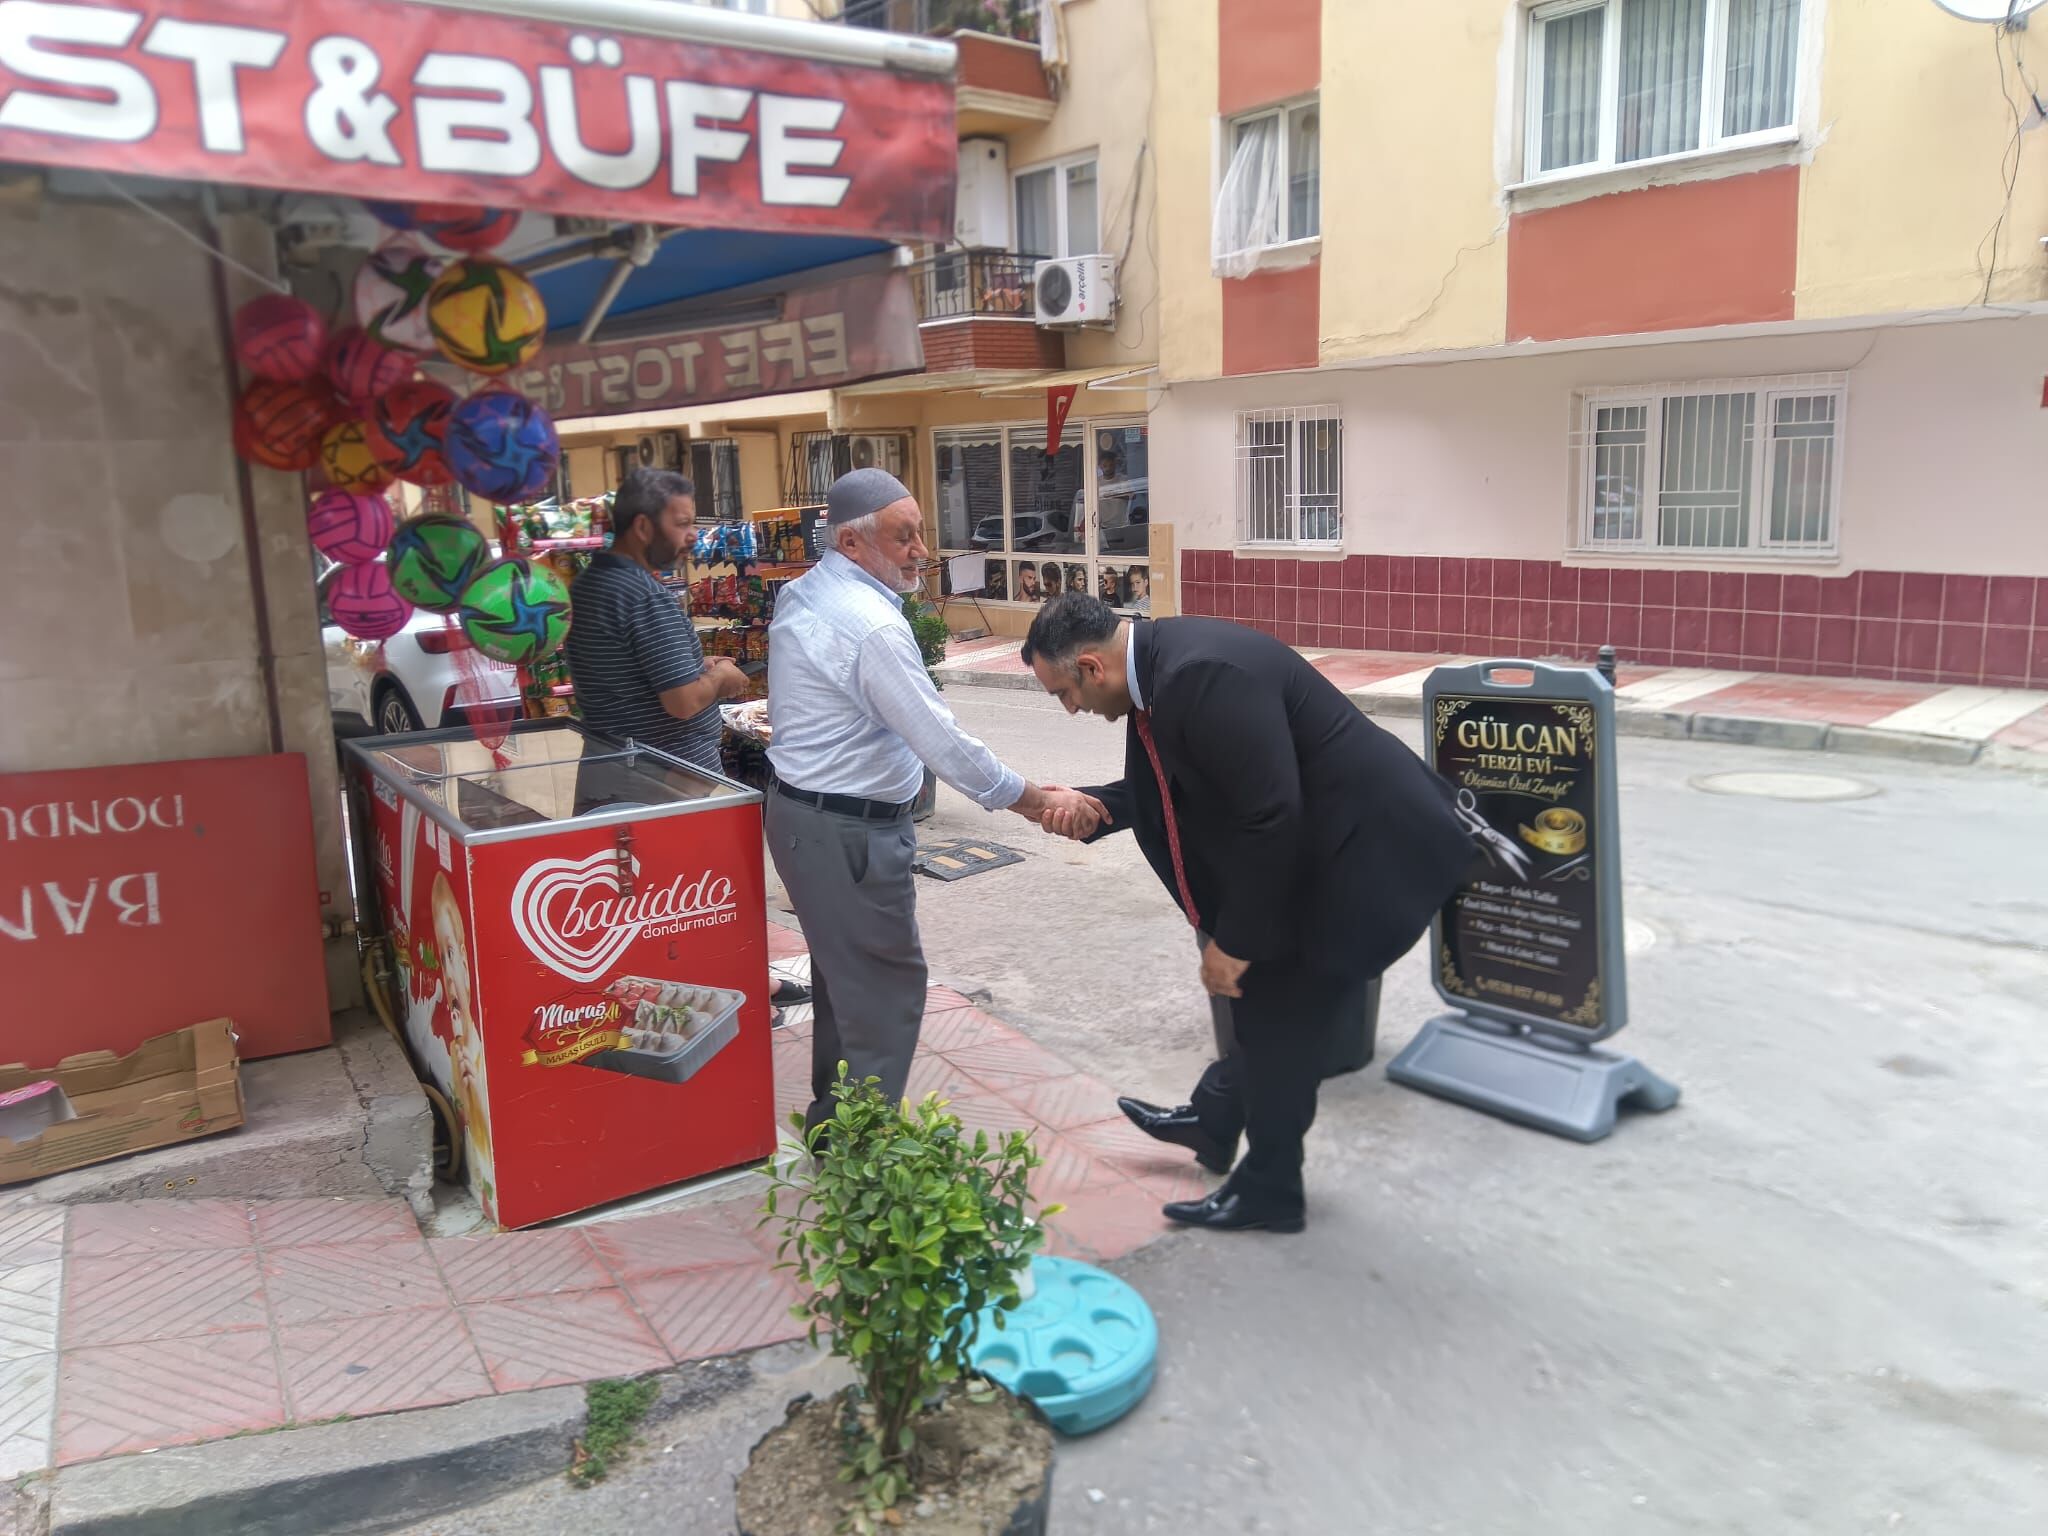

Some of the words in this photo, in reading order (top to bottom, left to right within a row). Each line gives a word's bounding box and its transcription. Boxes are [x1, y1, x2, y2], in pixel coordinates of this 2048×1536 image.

[1077, 260, 1087, 300] arçelik
[1457, 715, 1577, 757] GÜLCAN
[1478, 753, 1523, 772] TERZİ
[1526, 756, 1552, 775] EVİ
[561, 869, 737, 938] baniddo
[642, 909, 738, 939] dondurmaları
